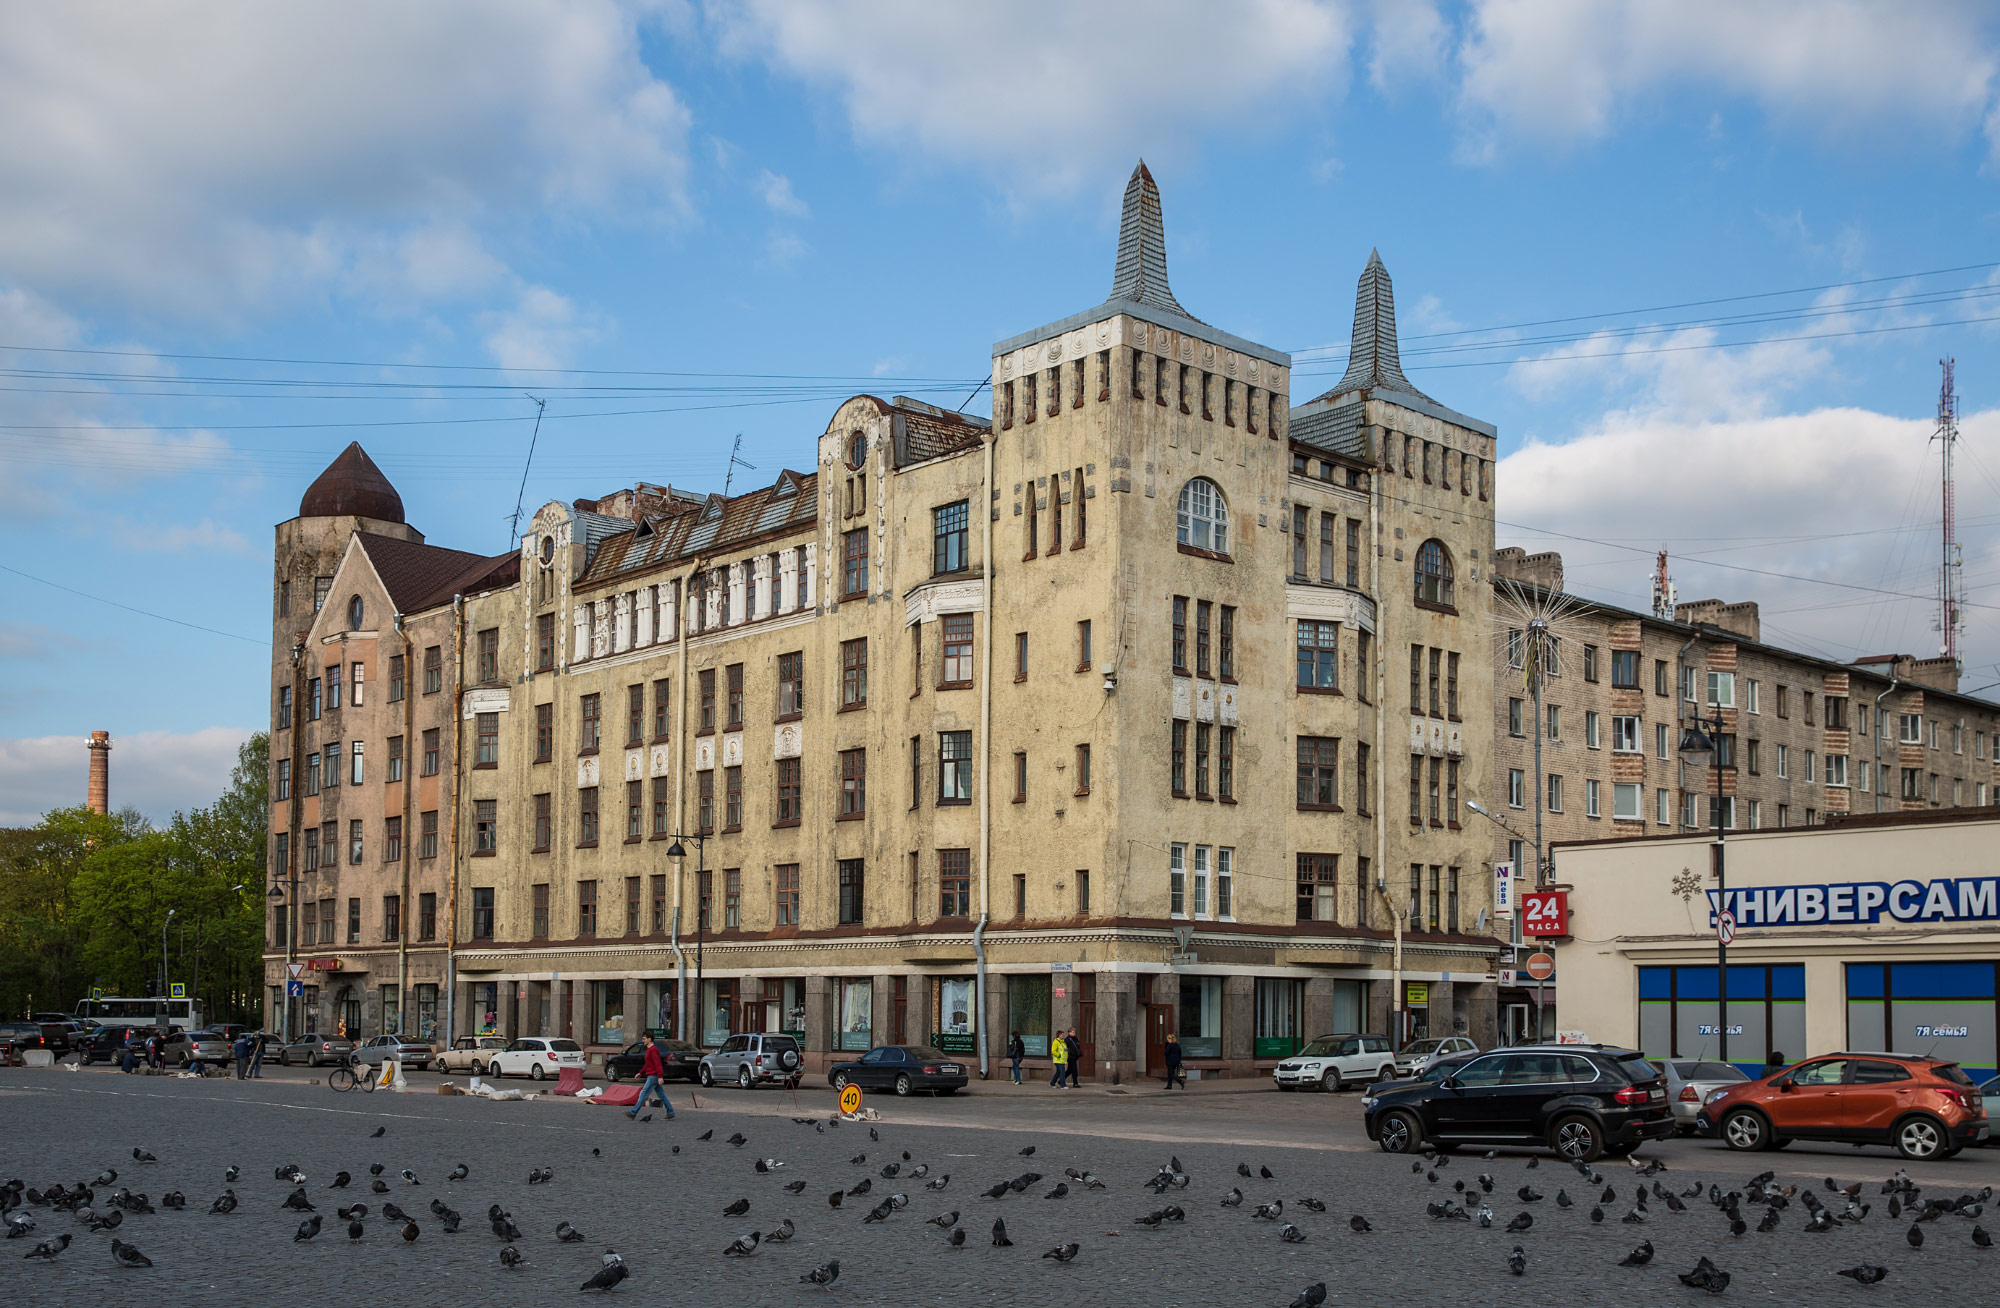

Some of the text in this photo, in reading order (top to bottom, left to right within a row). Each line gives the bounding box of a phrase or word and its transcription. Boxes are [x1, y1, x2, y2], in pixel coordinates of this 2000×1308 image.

[1709, 880, 1998, 925] УНИВЕРСАМ
[1526, 897, 1559, 920] 24
[1528, 923, 1560, 931] ЧАСА
[1699, 1025, 1742, 1034] 7Я смьЯ
[1916, 1026, 1967, 1036] 7Я семьЯ
[843, 1093, 857, 1105] 40
